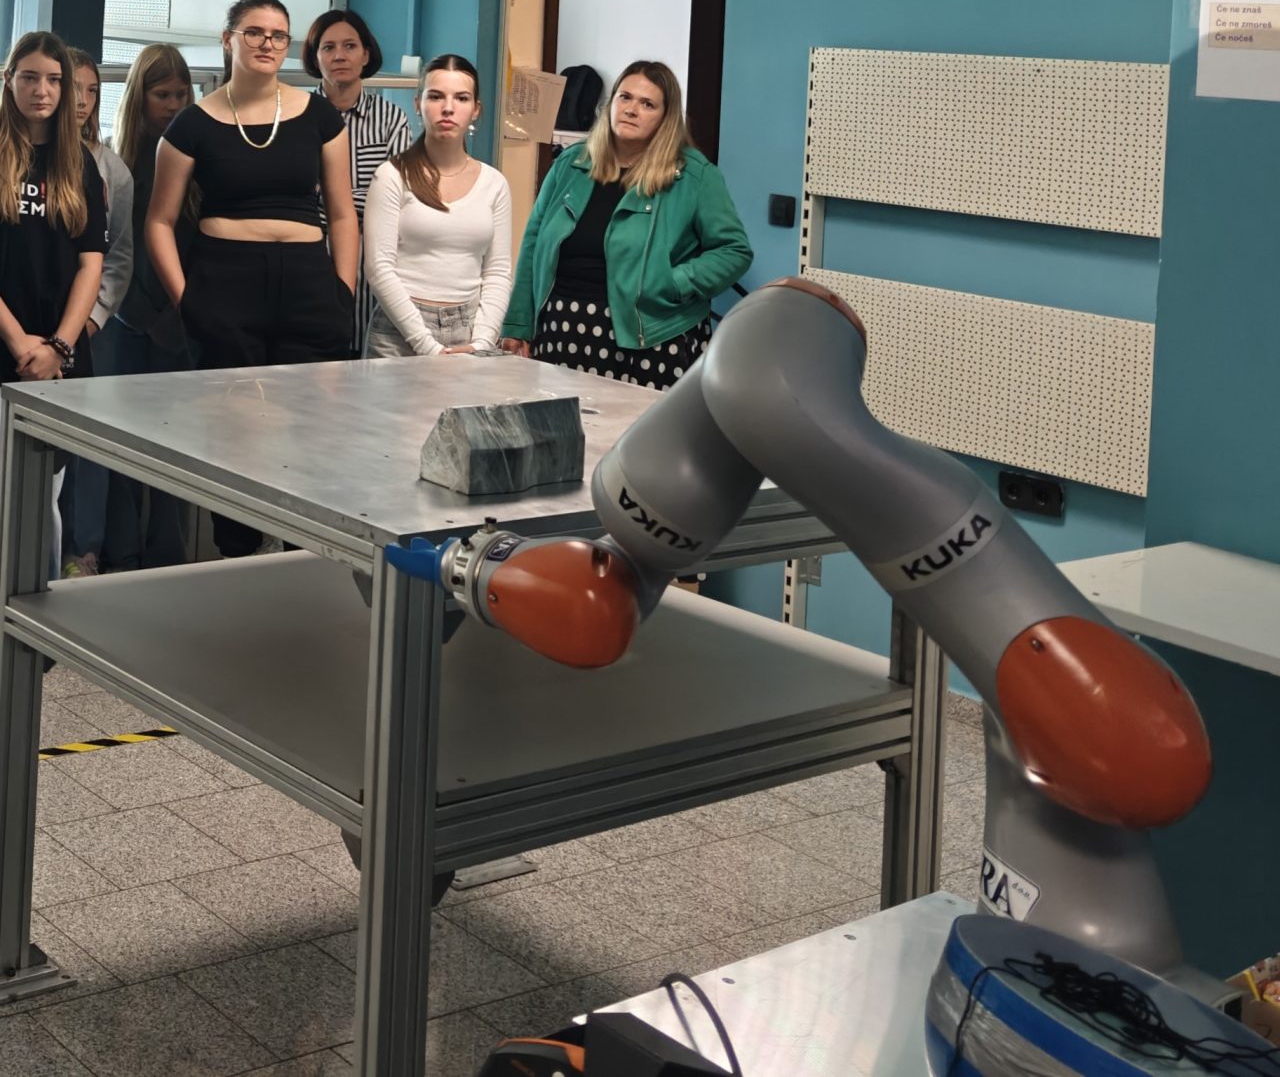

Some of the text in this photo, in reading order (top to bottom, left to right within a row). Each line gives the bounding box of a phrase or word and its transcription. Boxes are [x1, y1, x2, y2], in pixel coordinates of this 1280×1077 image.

[619, 486, 703, 551] KUKA
[901, 513, 993, 581] KUKA
[981, 854, 1014, 920] RA
